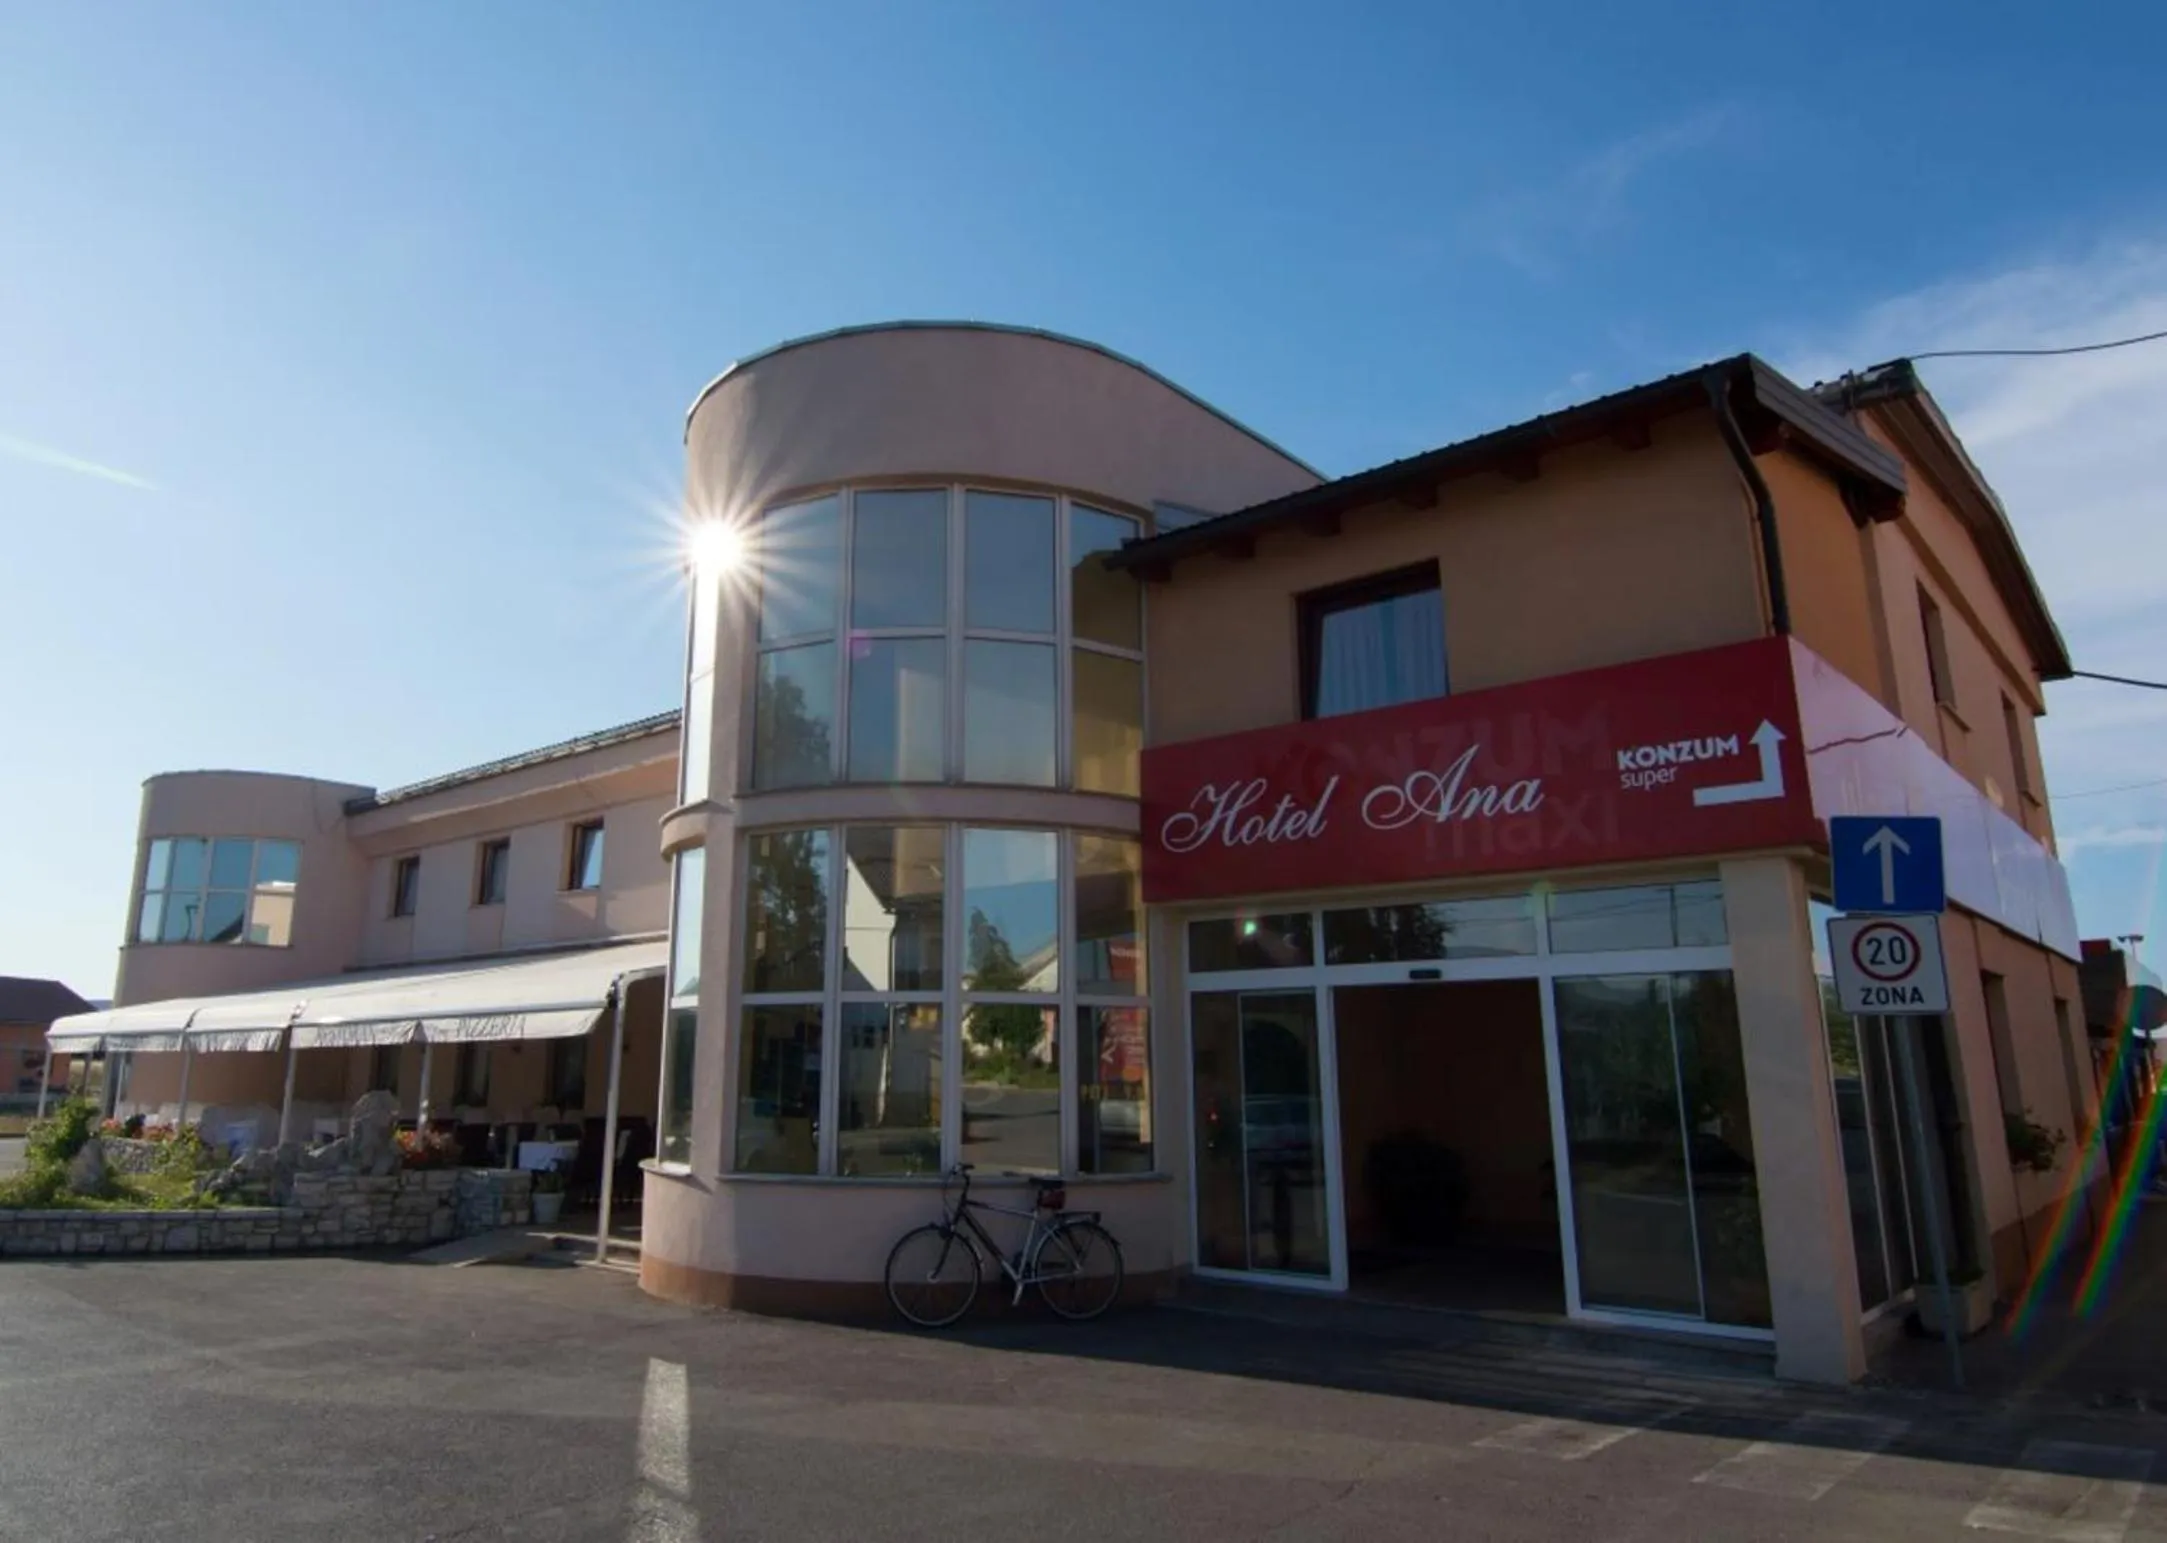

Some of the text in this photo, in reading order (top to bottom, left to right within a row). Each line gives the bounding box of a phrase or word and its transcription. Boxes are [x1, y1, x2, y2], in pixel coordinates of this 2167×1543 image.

[1617, 733, 1739, 770] KONZUM
[1620, 766, 1678, 790] super
[1161, 743, 1544, 853] Hotel Ana
[1866, 936, 1906, 966] 20
[1860, 986, 1925, 1006] ZONA
